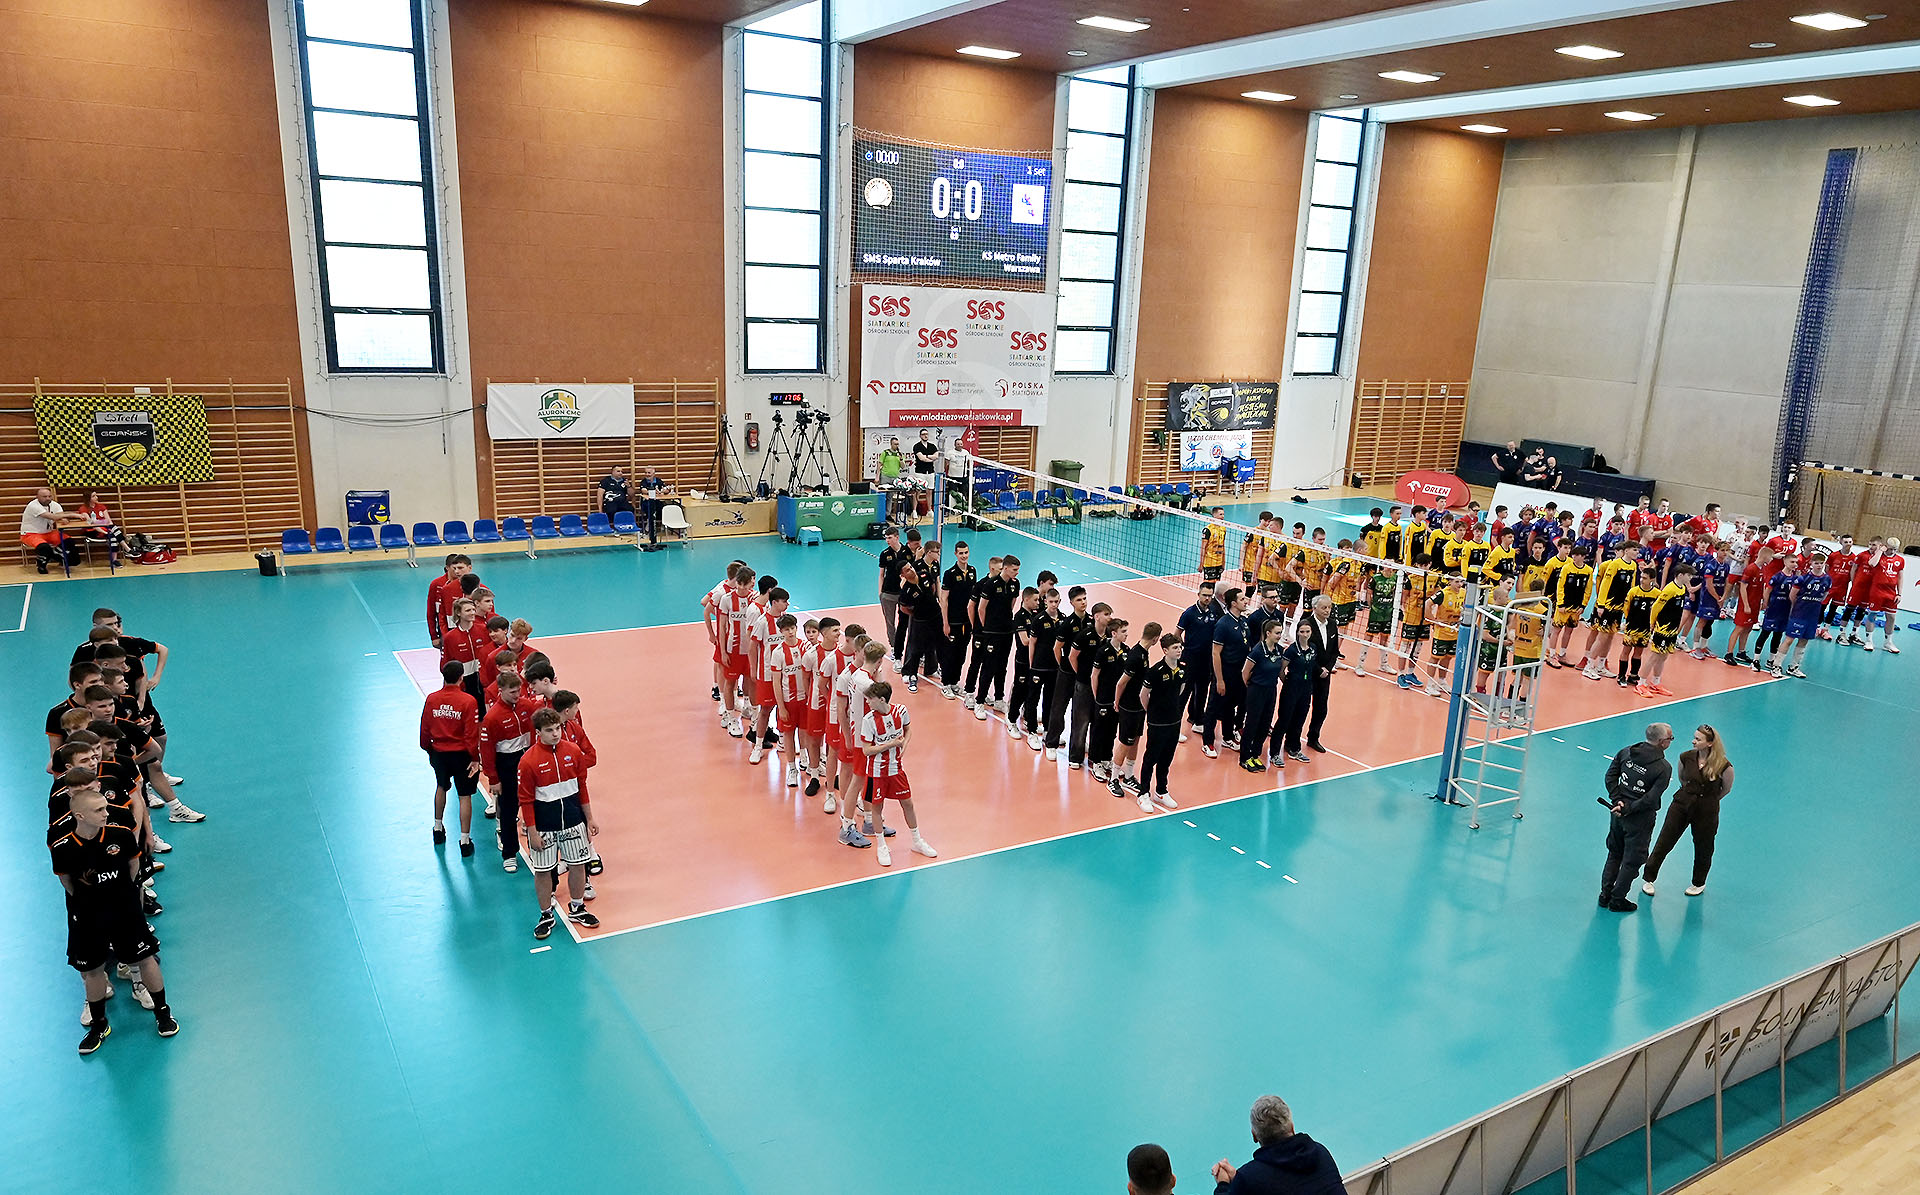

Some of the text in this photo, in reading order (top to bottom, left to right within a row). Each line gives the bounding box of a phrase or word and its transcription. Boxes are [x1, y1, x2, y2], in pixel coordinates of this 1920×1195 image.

[876, 150, 899, 165] 00:00
[1033, 167, 1046, 176] set
[932, 177, 982, 220] 0:0
[863, 254, 941, 267] SMS Sparta Kraków
[994, 252, 1016, 262] Metro
[1017, 253, 1041, 265] Family
[1003, 264, 1041, 274] Warszawa
[868, 295, 911, 317] SOS
[967, 299, 1006, 321] SOS
[917, 327, 959, 349] SOS
[1010, 330, 1048, 352] SOS
[890, 383, 925, 393] ORLEN
[1012, 381, 1044, 389] POLSKA
[537, 409, 565, 417] ALURON
[100, 429, 148, 437] GDAŃSK
[1424, 485, 1450, 495] ORLEN
[1641, 601, 1647, 610] 2
[1519, 622, 1529, 635] 10
[97, 870, 119, 883] JSW
